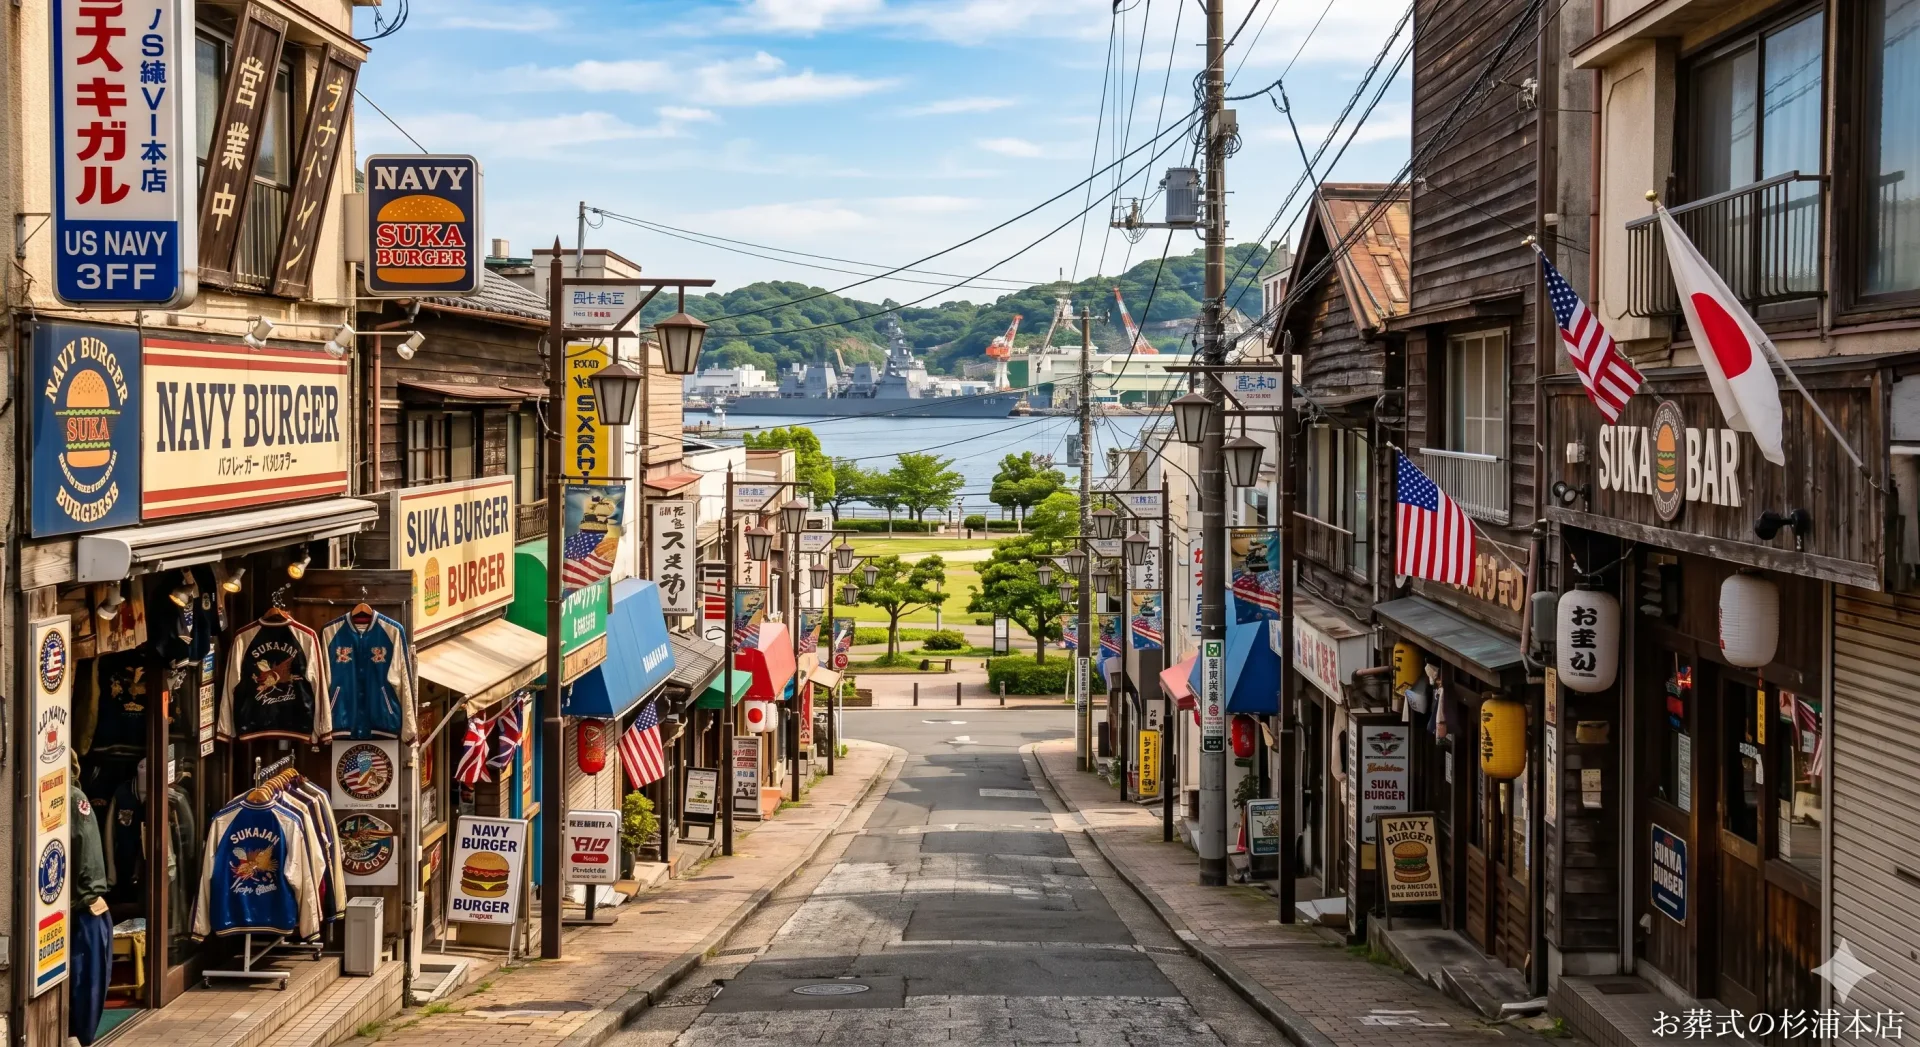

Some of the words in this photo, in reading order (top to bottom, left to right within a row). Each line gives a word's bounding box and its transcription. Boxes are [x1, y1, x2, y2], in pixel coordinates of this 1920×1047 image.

[210, 56, 265, 231] 営業中
[374, 166, 469, 191] NAVY
[64, 230, 98, 257] US
[104, 230, 168, 257] NAVY
[376, 223, 466, 248] SUKA
[376, 248, 467, 268] BURGER
[76, 262, 156, 290] 3FF
[44, 340, 77, 405] NAVY
[80, 336, 129, 406] BURGER
[66, 416, 111, 443] SUKA
[156, 381, 236, 453] NAVY
[243, 384, 340, 448] BURGER
[1599, 423, 1653, 496] SUKA
[1685, 427, 1742, 508] BAR
[406, 506, 450, 558] SUKA
[454, 495, 509, 545] BURGER
[447, 552, 506, 607] BURGER
[1364, 790, 1406, 801] BURGER
[1370, 779, 1398, 790] SUKA
[230, 827, 281, 846] SUKAJAN
[471, 823, 511, 838] NAVY
[1386, 831, 1434, 846] BURGER
[1387, 821, 1429, 834] NAVY
[461, 838, 518, 853] BURGER
[1653, 862, 1684, 900] BURGER
[452, 898, 510, 914] BURGER
